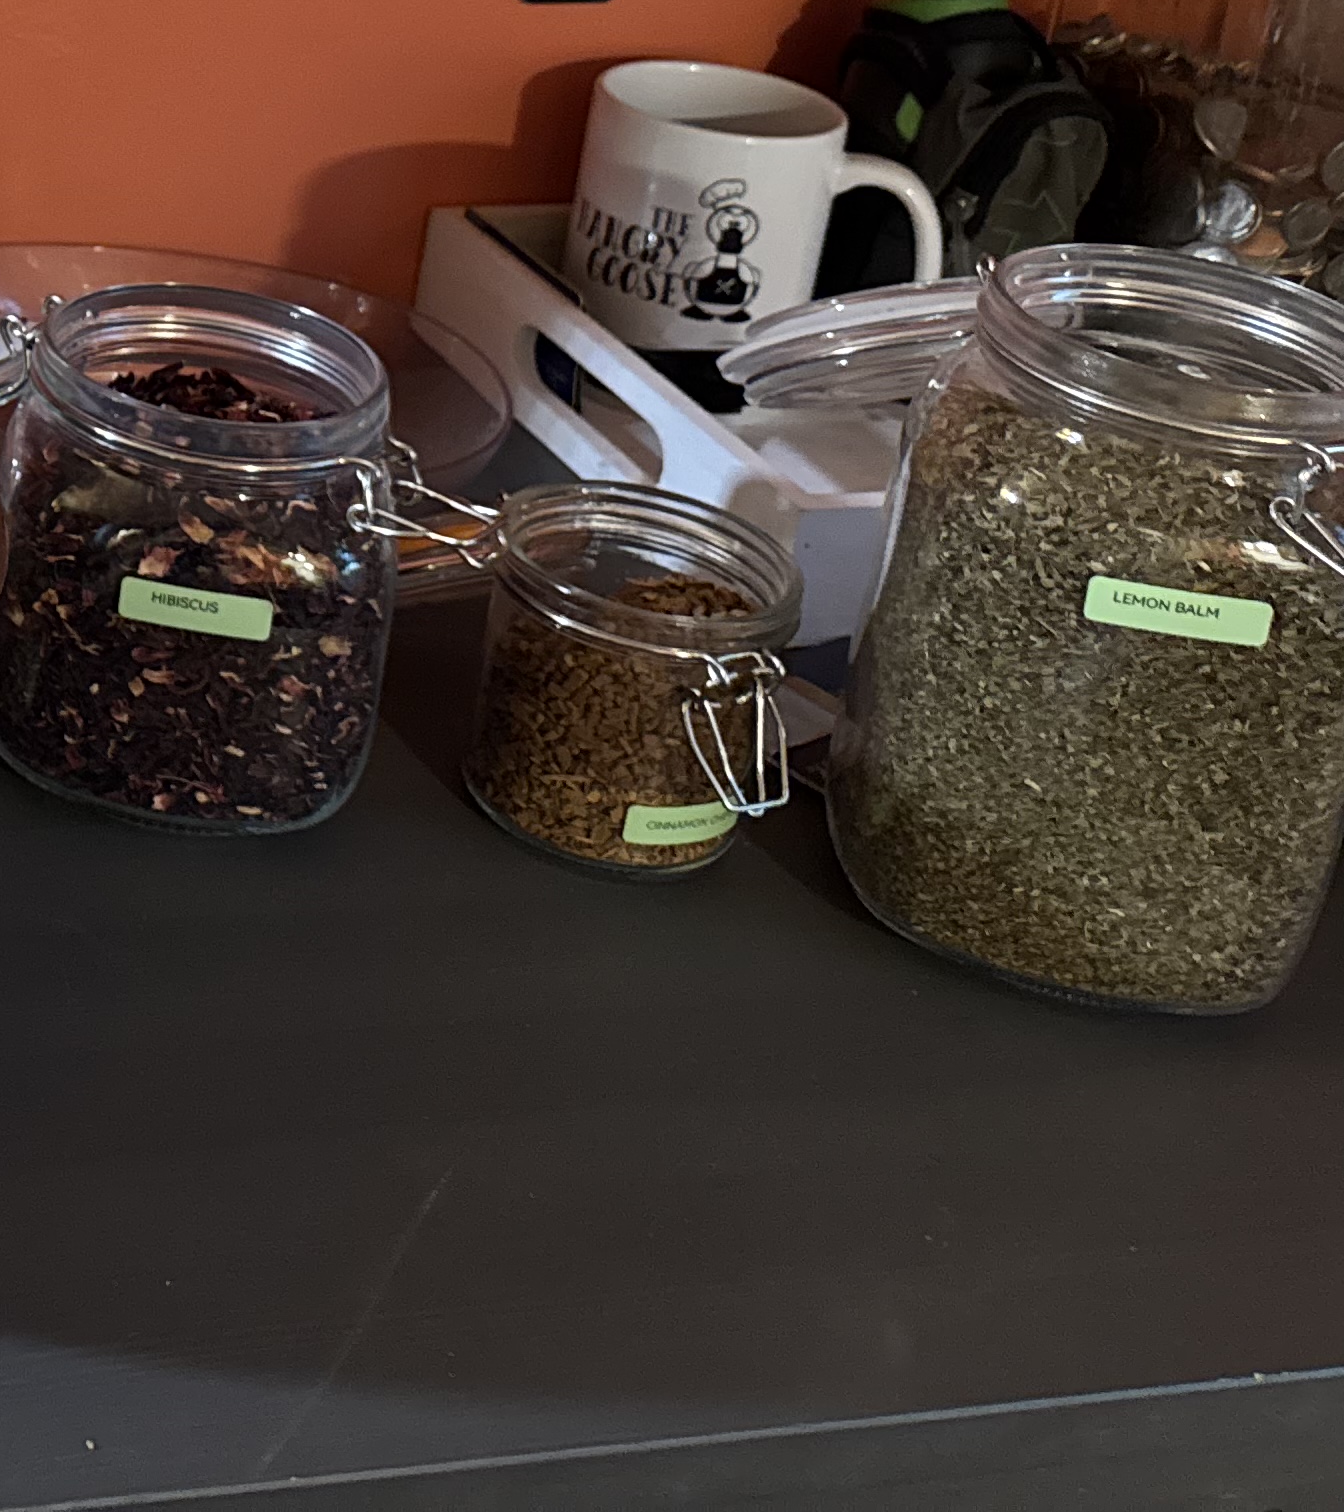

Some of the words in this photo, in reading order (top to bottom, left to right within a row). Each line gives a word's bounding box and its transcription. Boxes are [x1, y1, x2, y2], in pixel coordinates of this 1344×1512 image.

[651, 206, 697, 237] THE
[151, 591, 219, 614] HIBISCUS
[1113, 590, 1171, 612] LEMON
[1174, 601, 1221, 620] BALM
